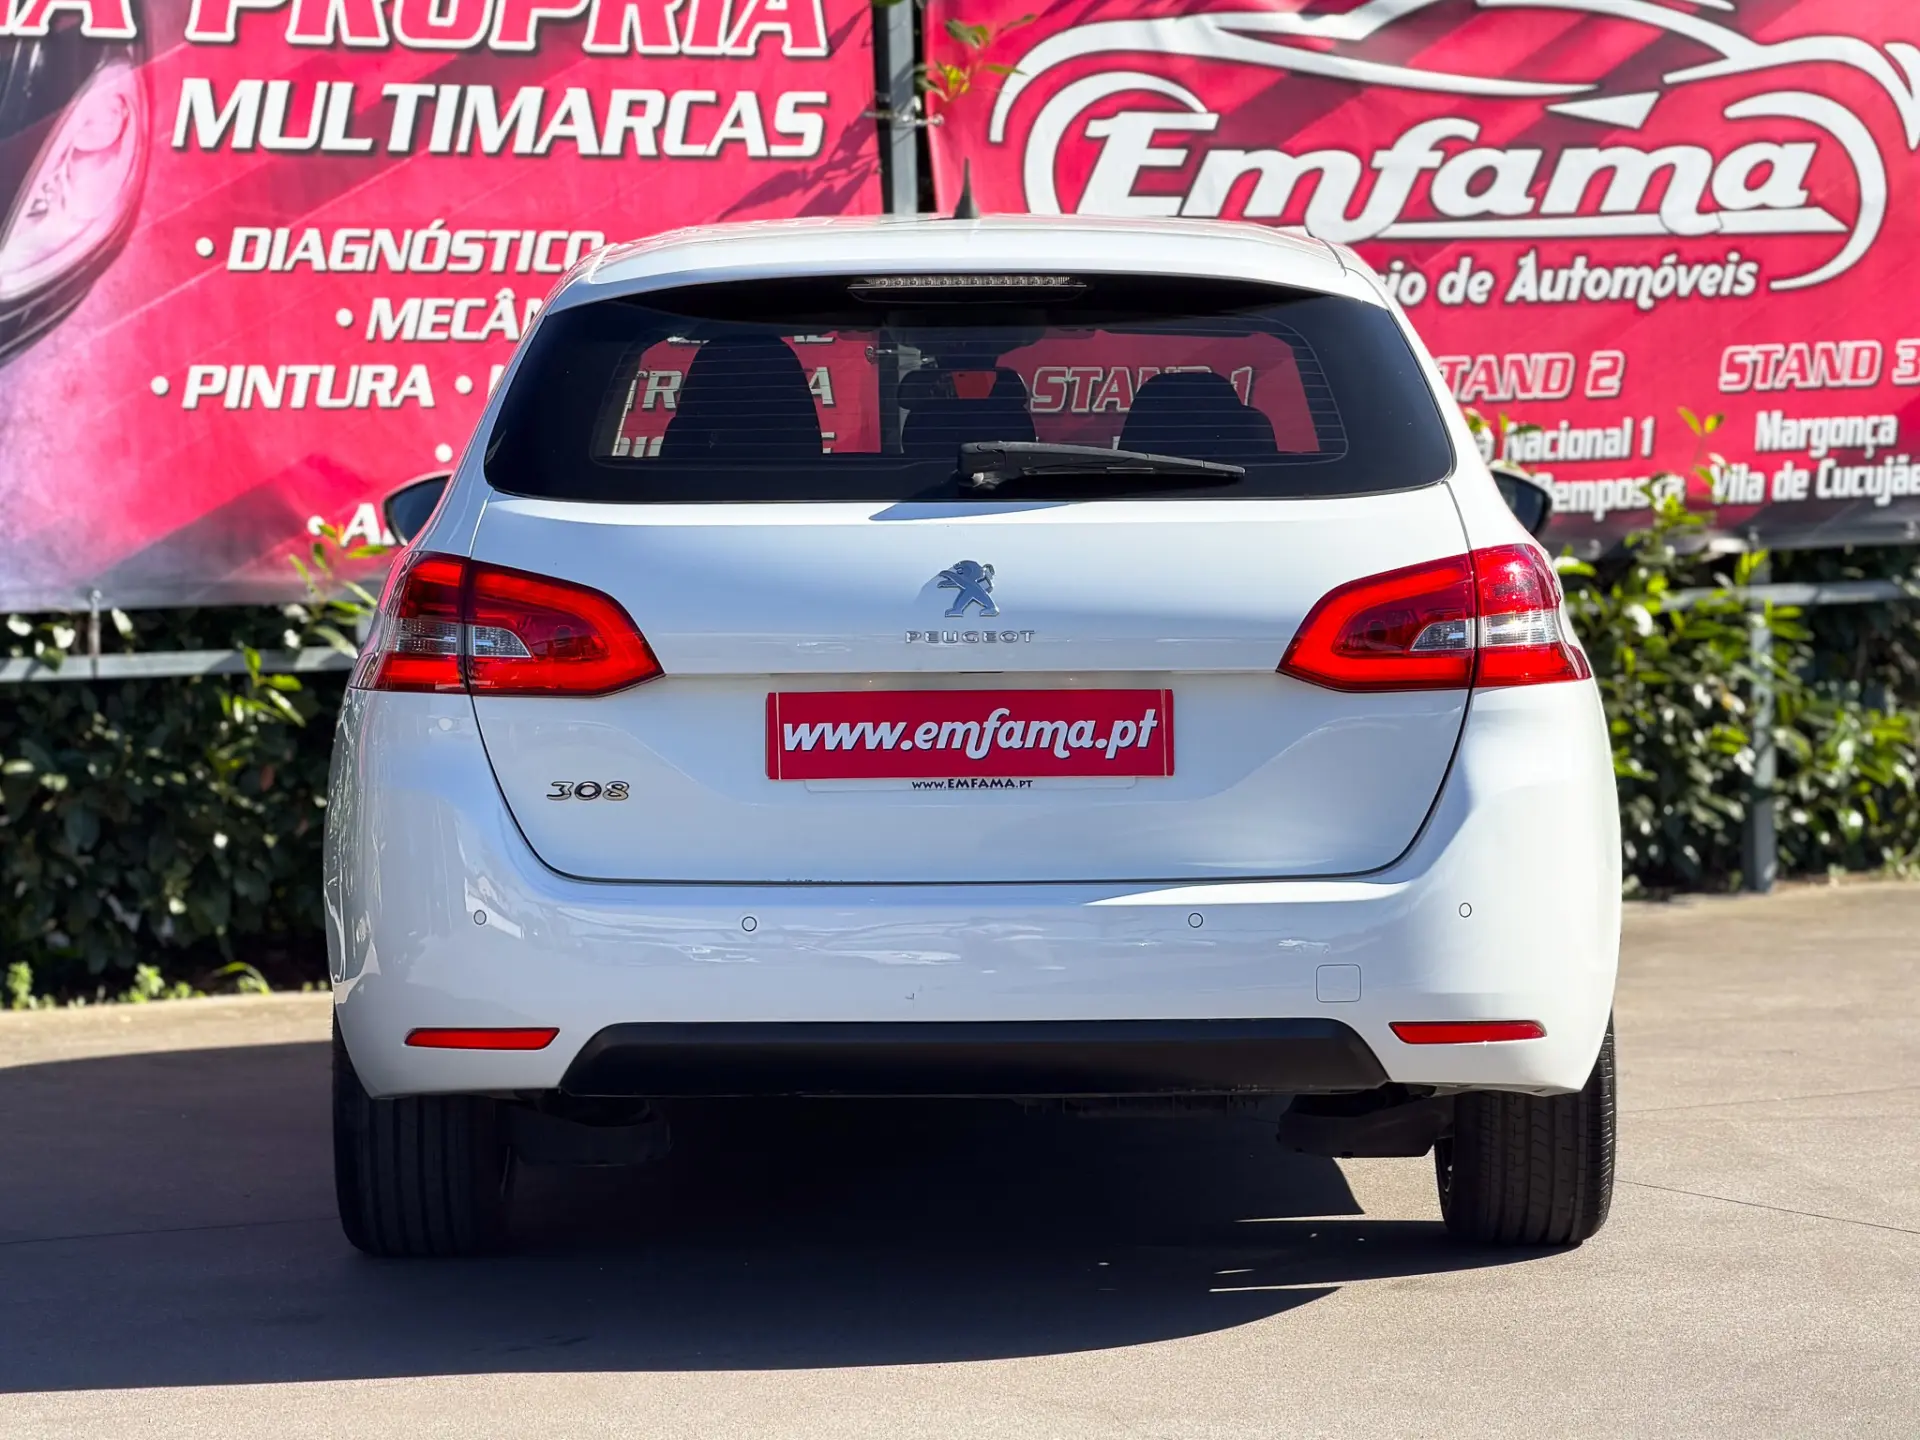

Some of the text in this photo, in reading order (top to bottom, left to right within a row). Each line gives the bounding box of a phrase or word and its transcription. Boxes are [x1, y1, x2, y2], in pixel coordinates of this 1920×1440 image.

[171, 77, 827, 158] MULTIMARCAS
[1076, 116, 1818, 243] Emfama
[226, 219, 605, 273] DIAGNÓSTICO
[1437, 255, 1494, 305] de
[1504, 248, 1758, 311] Automóveis
[181, 363, 436, 410] PINTURA
[1585, 350, 1626, 399] 2
[1718, 337, 1920, 393] STAND 3
[1501, 416, 1635, 463] Nacional
[1639, 416, 1656, 457] 1
[1754, 409, 1899, 459] Margonça
[1708, 461, 1766, 505] Vila
[1771, 459, 1811, 501] de
[904, 629, 1037, 645] PEUGEOT
[783, 706, 1159, 761] www.emfama.pt
[546, 780, 631, 802] 308
